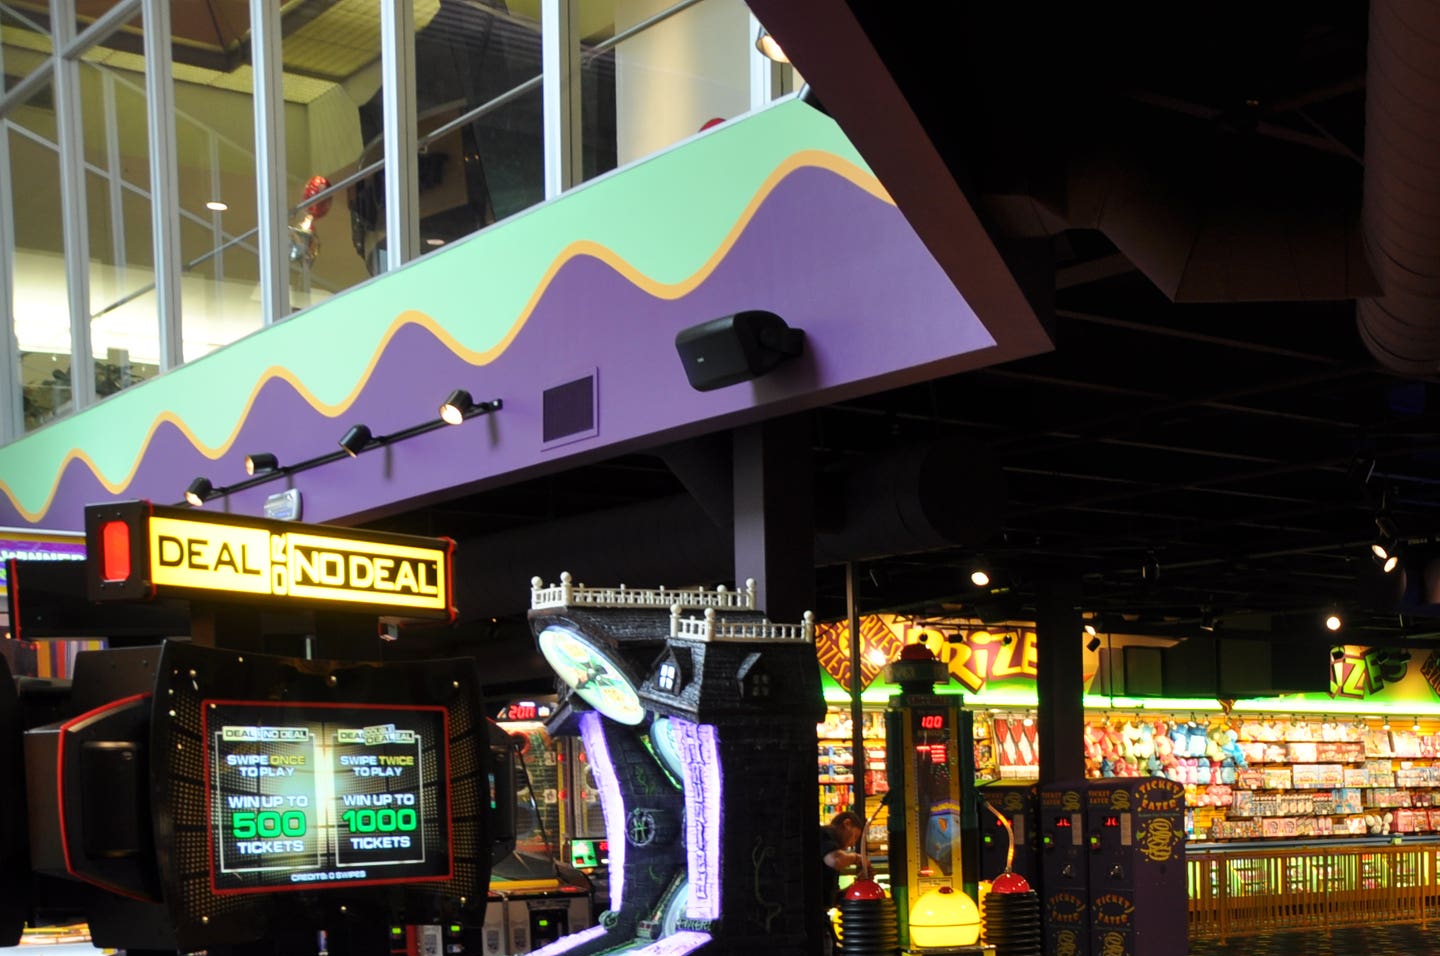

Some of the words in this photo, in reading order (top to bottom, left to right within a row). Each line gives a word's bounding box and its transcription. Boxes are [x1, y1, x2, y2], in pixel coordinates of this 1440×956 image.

[157, 535, 262, 576] DEAL
[270, 533, 288, 596] OR
[295, 548, 345, 586] NO
[349, 555, 438, 595] DEAL
[921, 715, 943, 729] 100
[226, 754, 269, 766] SWIPE
[270, 755, 305, 766] ONCE
[340, 755, 378, 766] SWIPE
[378, 755, 415, 766] TWICE
[239, 766, 261, 777] TO
[262, 766, 295, 777] PLAY
[353, 766, 371, 777] TO
[371, 766, 403, 777] PLAY
[1138, 779, 1181, 794] TICKET
[228, 795, 262, 808] WIN
[262, 795, 283, 808] UP
[286, 795, 308, 807] TO
[342, 794, 373, 806] WIN
[372, 794, 392, 806] UP
[393, 793, 415, 805] TO
[1139, 799, 1178, 812] EATER
[232, 810, 307, 839] 500
[341, 808, 417, 833] 1000
[236, 839, 305, 855] TICKETS
[350, 836, 411, 849] TICKETS
[335, 869, 367, 880] SWIPES
